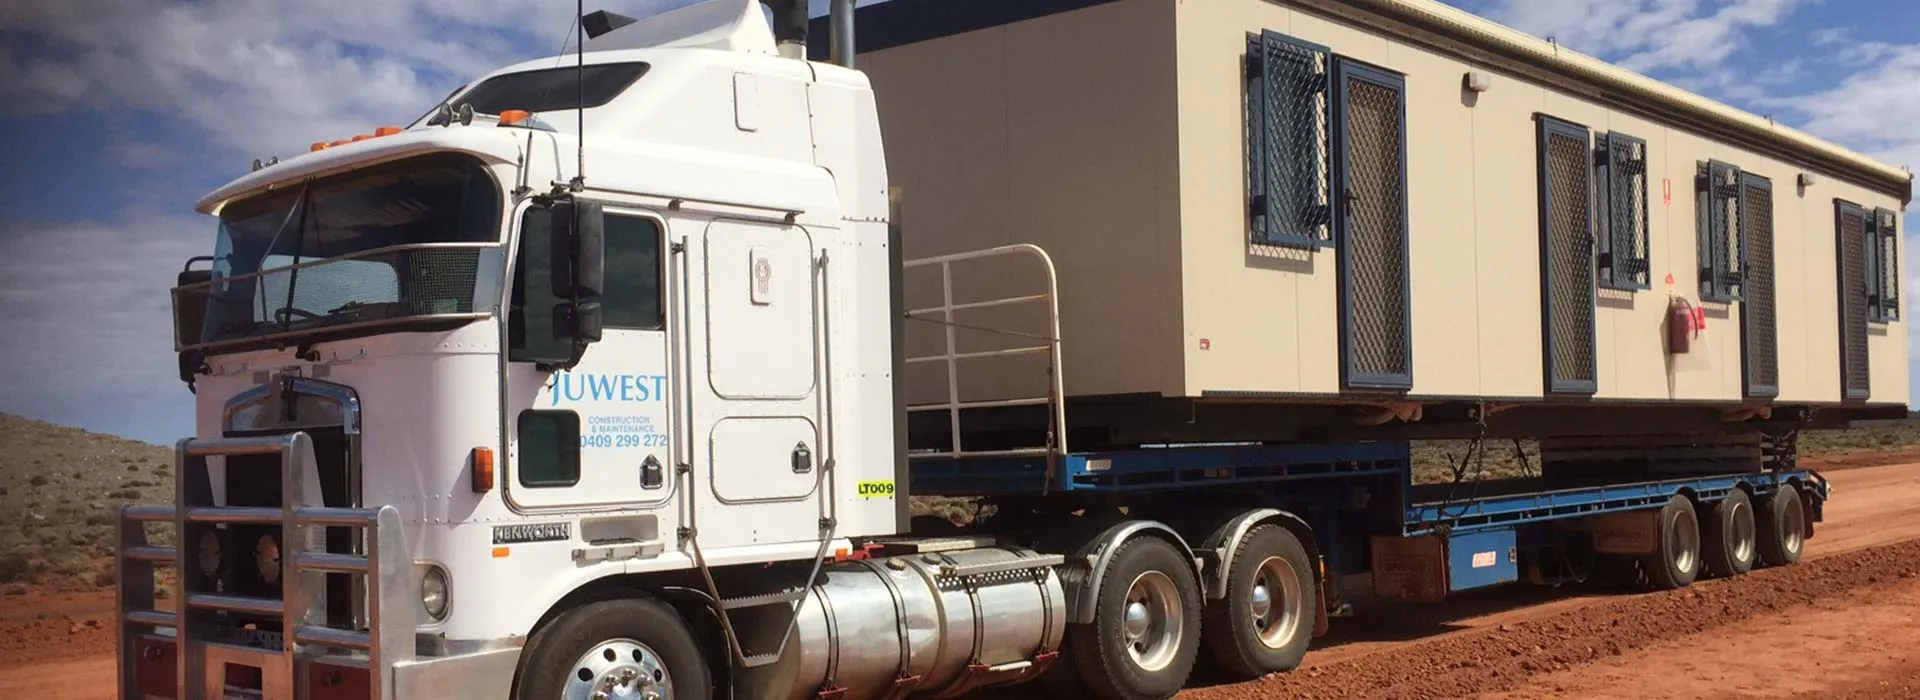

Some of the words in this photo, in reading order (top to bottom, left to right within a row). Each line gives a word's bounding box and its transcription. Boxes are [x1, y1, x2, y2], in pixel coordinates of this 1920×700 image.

[551, 373, 667, 406] JUWEST
[588, 416, 650, 424] CONSTRUCTION
[580, 434, 612, 448] 0409
[616, 434, 640, 448] 299
[644, 434, 667, 447] 272
[494, 523, 569, 542] KENWORTH
